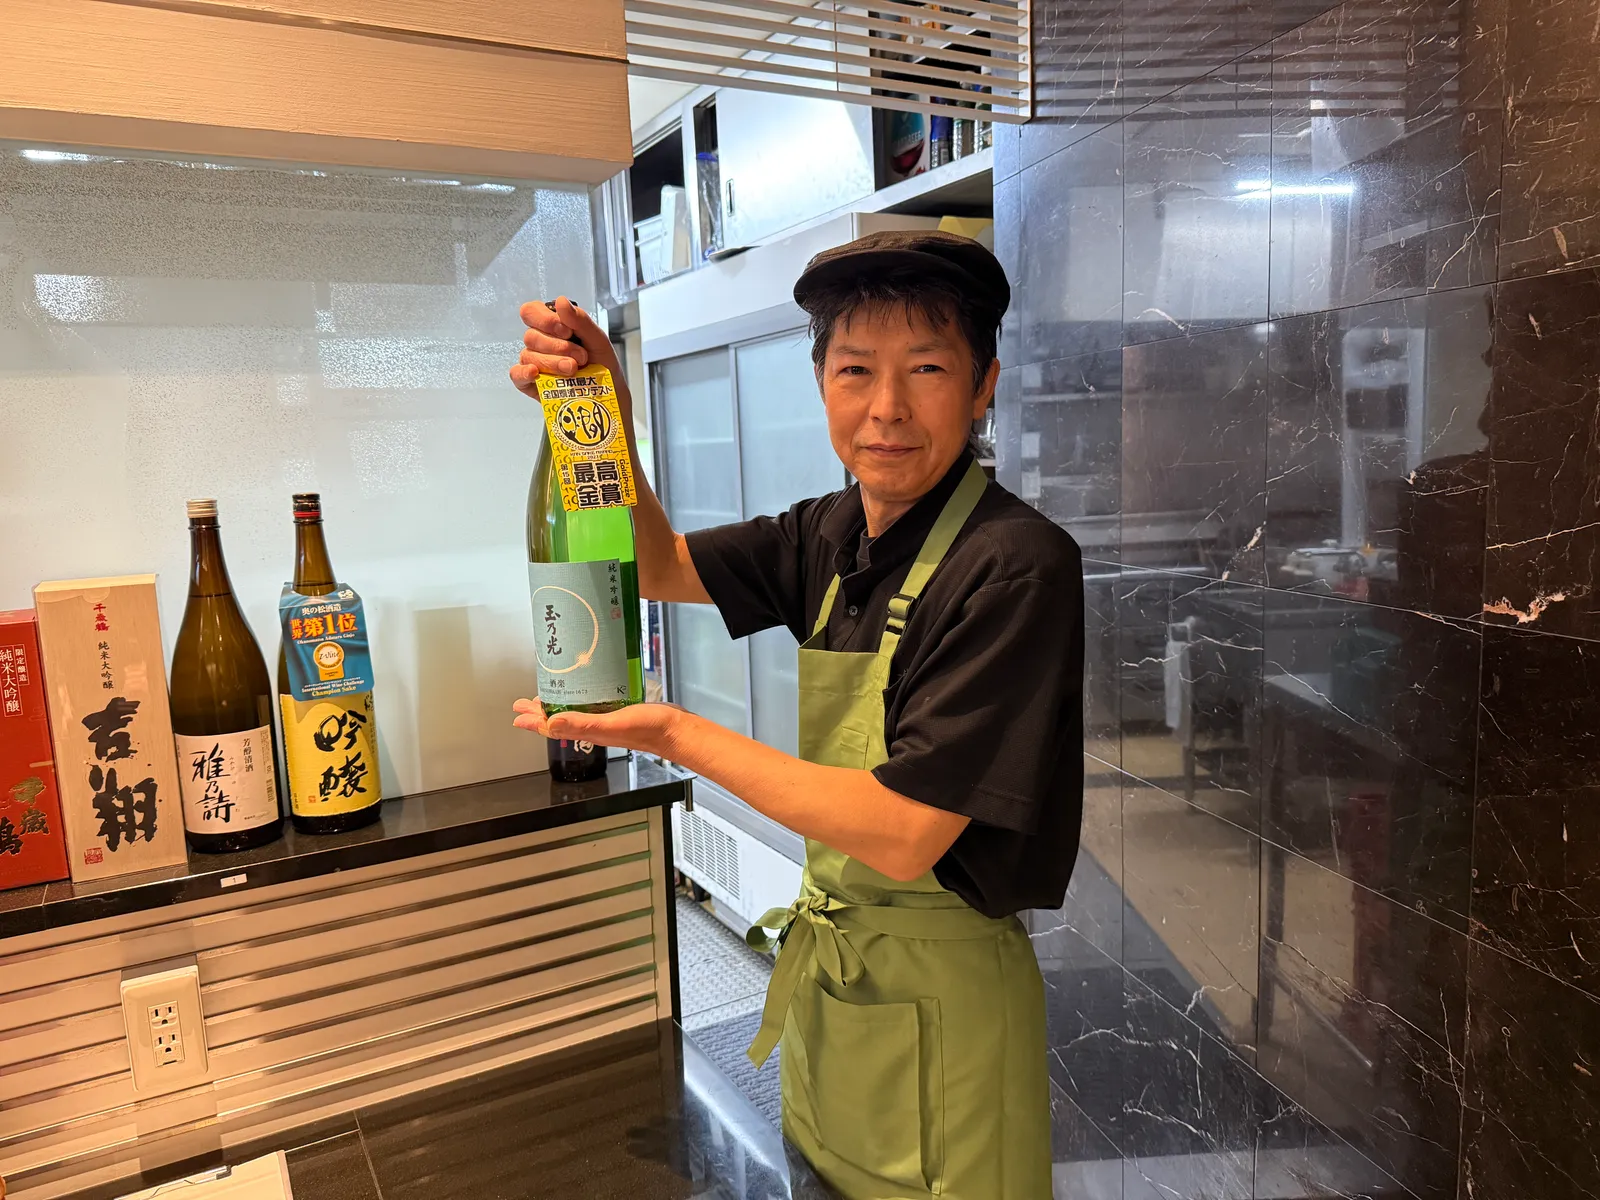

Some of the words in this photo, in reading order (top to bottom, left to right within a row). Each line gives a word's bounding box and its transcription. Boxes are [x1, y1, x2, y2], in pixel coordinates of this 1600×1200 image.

[556, 377, 597, 387] 日本最大
[573, 461, 618, 483] 最高
[577, 483, 622, 506] 金賞
[608, 562, 619, 606] 純米吟醸
[290, 618, 304, 640] 世界
[303, 612, 358, 638] 第1位
[544, 604, 562, 656] 玉乃光
[0, 649, 20, 713] 純米大吟醸
[15, 648, 27, 682] 限定醸造
[98, 641, 114, 690] 純米大吟醸
[311, 688, 341, 697] Champion
[82, 697, 158, 853] 吉翔
[313, 709, 368, 802] 吟醸
[189, 743, 235, 823] 雅乃詩
